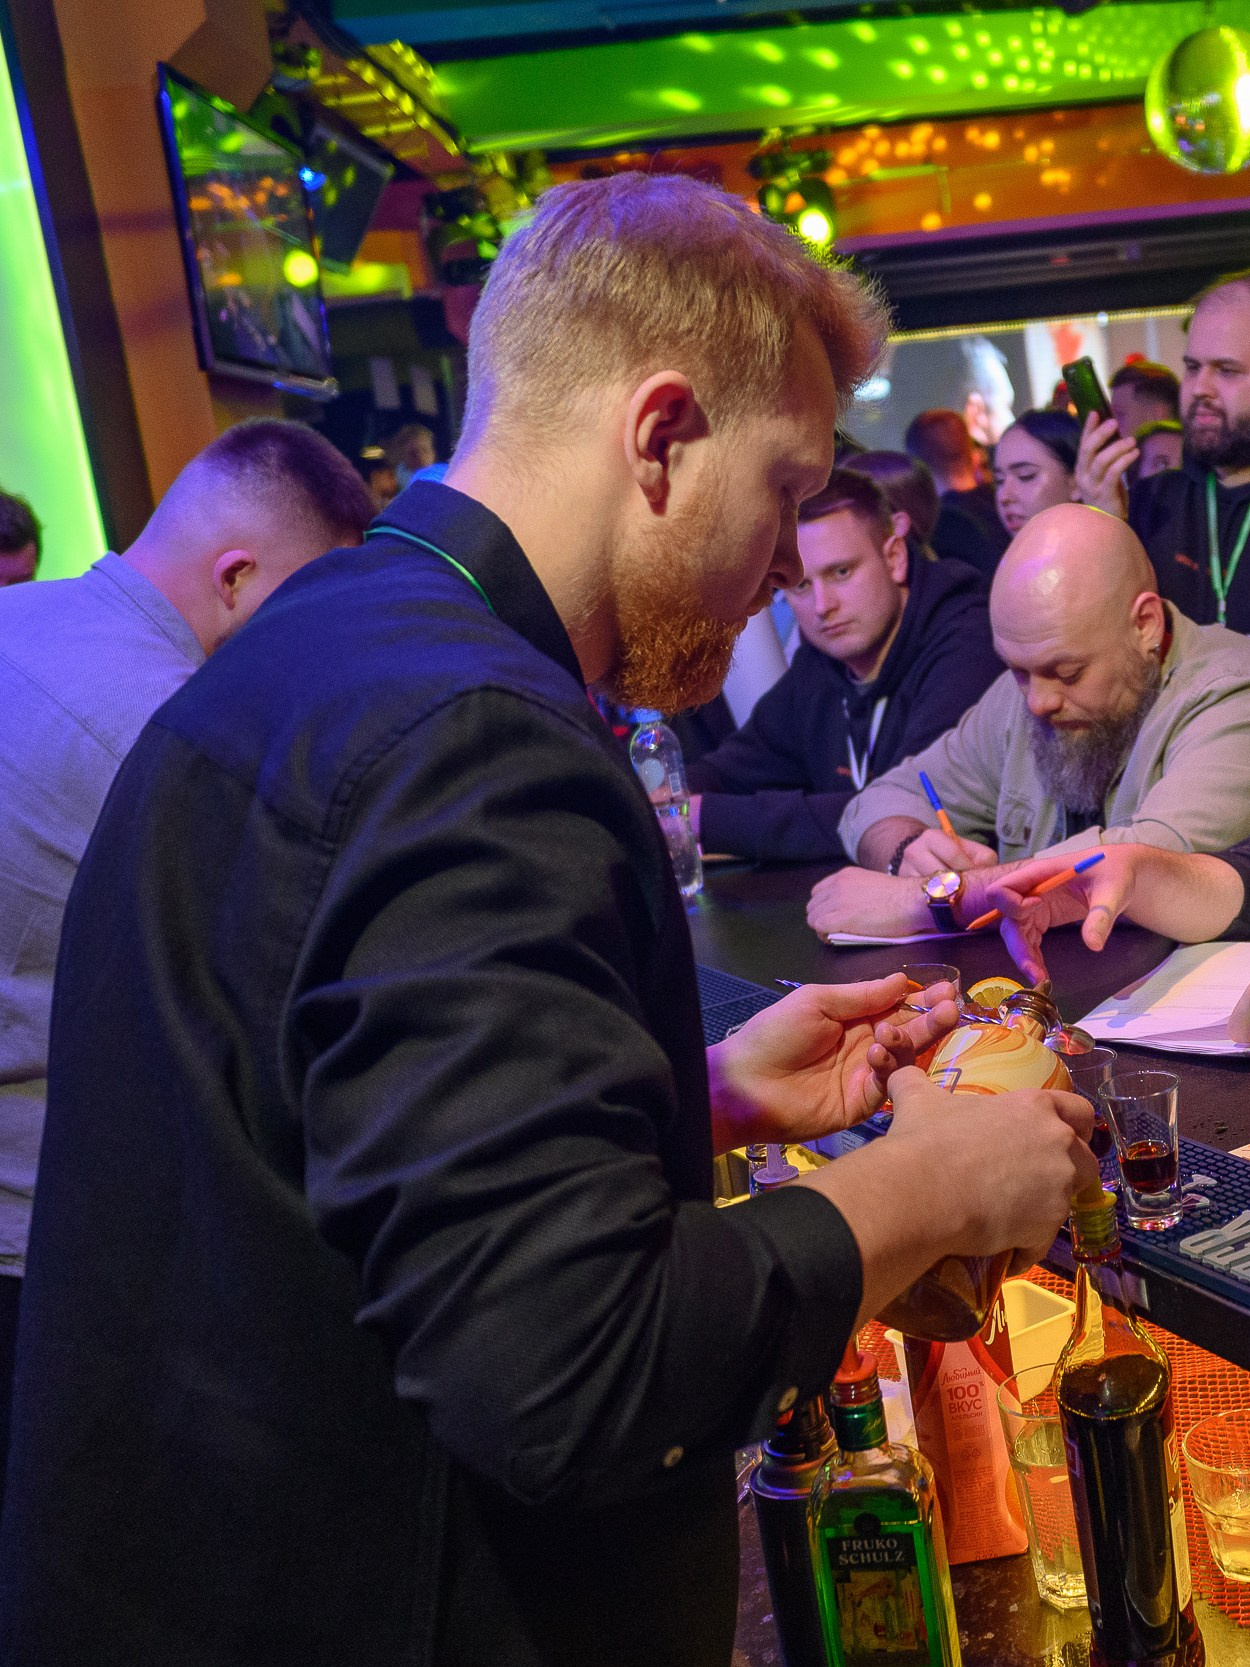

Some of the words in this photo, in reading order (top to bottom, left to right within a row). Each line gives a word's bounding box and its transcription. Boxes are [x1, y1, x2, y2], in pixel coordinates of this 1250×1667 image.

[941, 1367, 982, 1385] Любимый
[948, 1399, 983, 1414] ВКУС
[842, 1538, 898, 1551] FRUKO
[839, 1551, 905, 1566] SCHULZ
